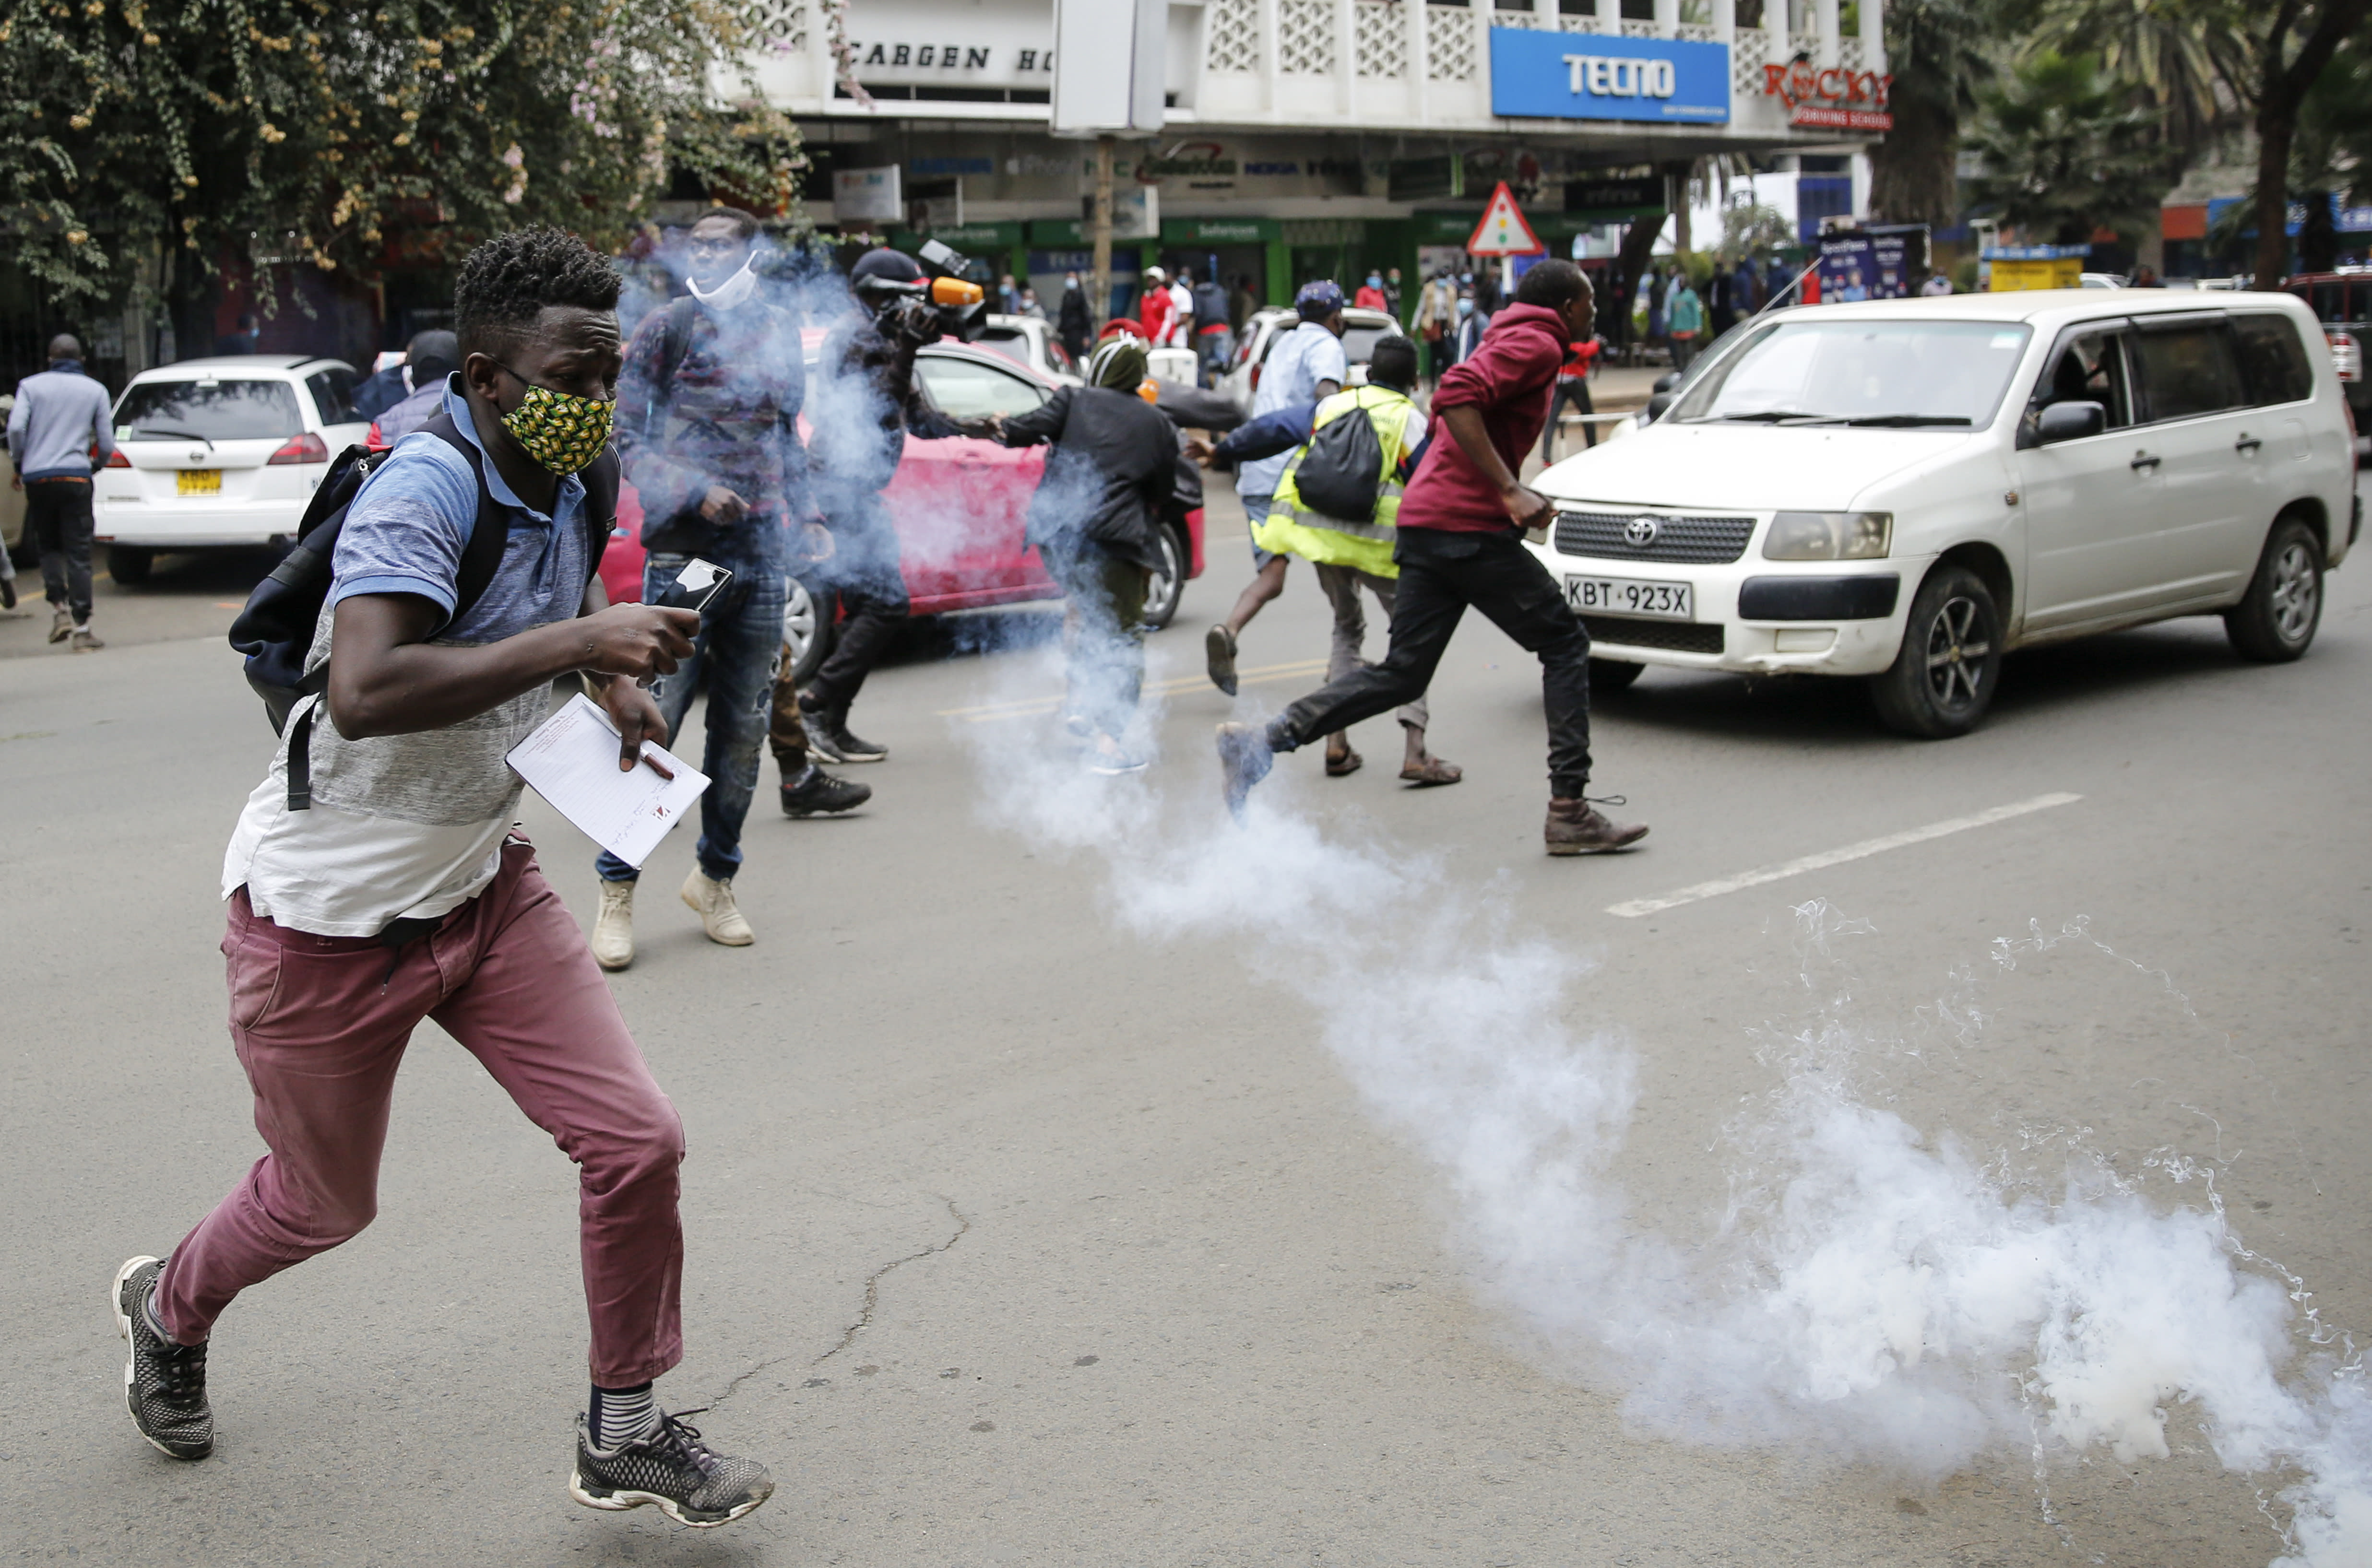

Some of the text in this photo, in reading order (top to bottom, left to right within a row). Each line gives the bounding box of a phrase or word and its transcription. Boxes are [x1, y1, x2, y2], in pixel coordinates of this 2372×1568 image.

[1562, 54, 1676, 98] TECNO
[1763, 61, 1894, 109] ROCKY
[1803, 107, 1891, 128] DRIVING SCHOOL
[1569, 581, 1686, 612] KBT 923X
